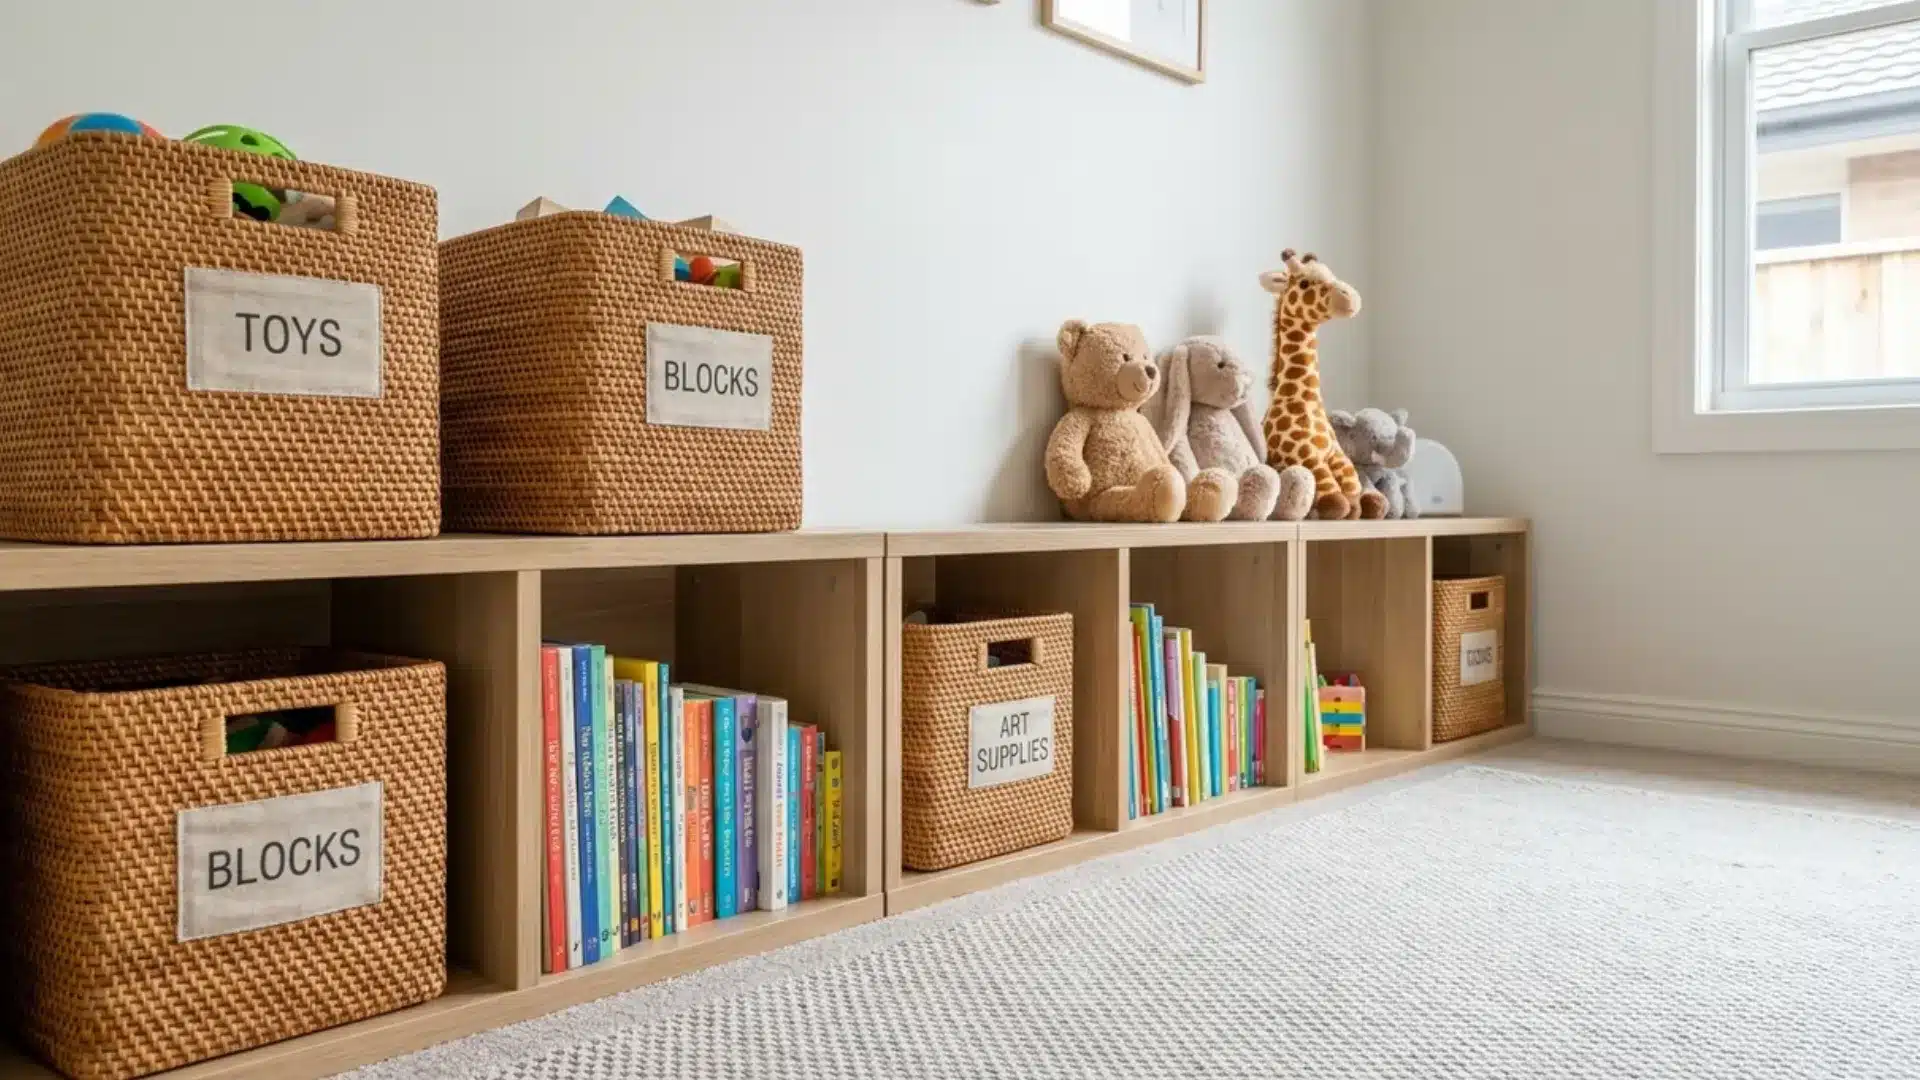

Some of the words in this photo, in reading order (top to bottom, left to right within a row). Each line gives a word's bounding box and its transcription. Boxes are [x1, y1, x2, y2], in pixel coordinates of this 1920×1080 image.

[235, 312, 342, 358] TOYS
[664, 360, 760, 398] BLOCKS
[1000, 711, 1030, 738] ART
[976, 737, 1049, 773] SUPPLIES
[207, 827, 361, 891] BLOCKS
